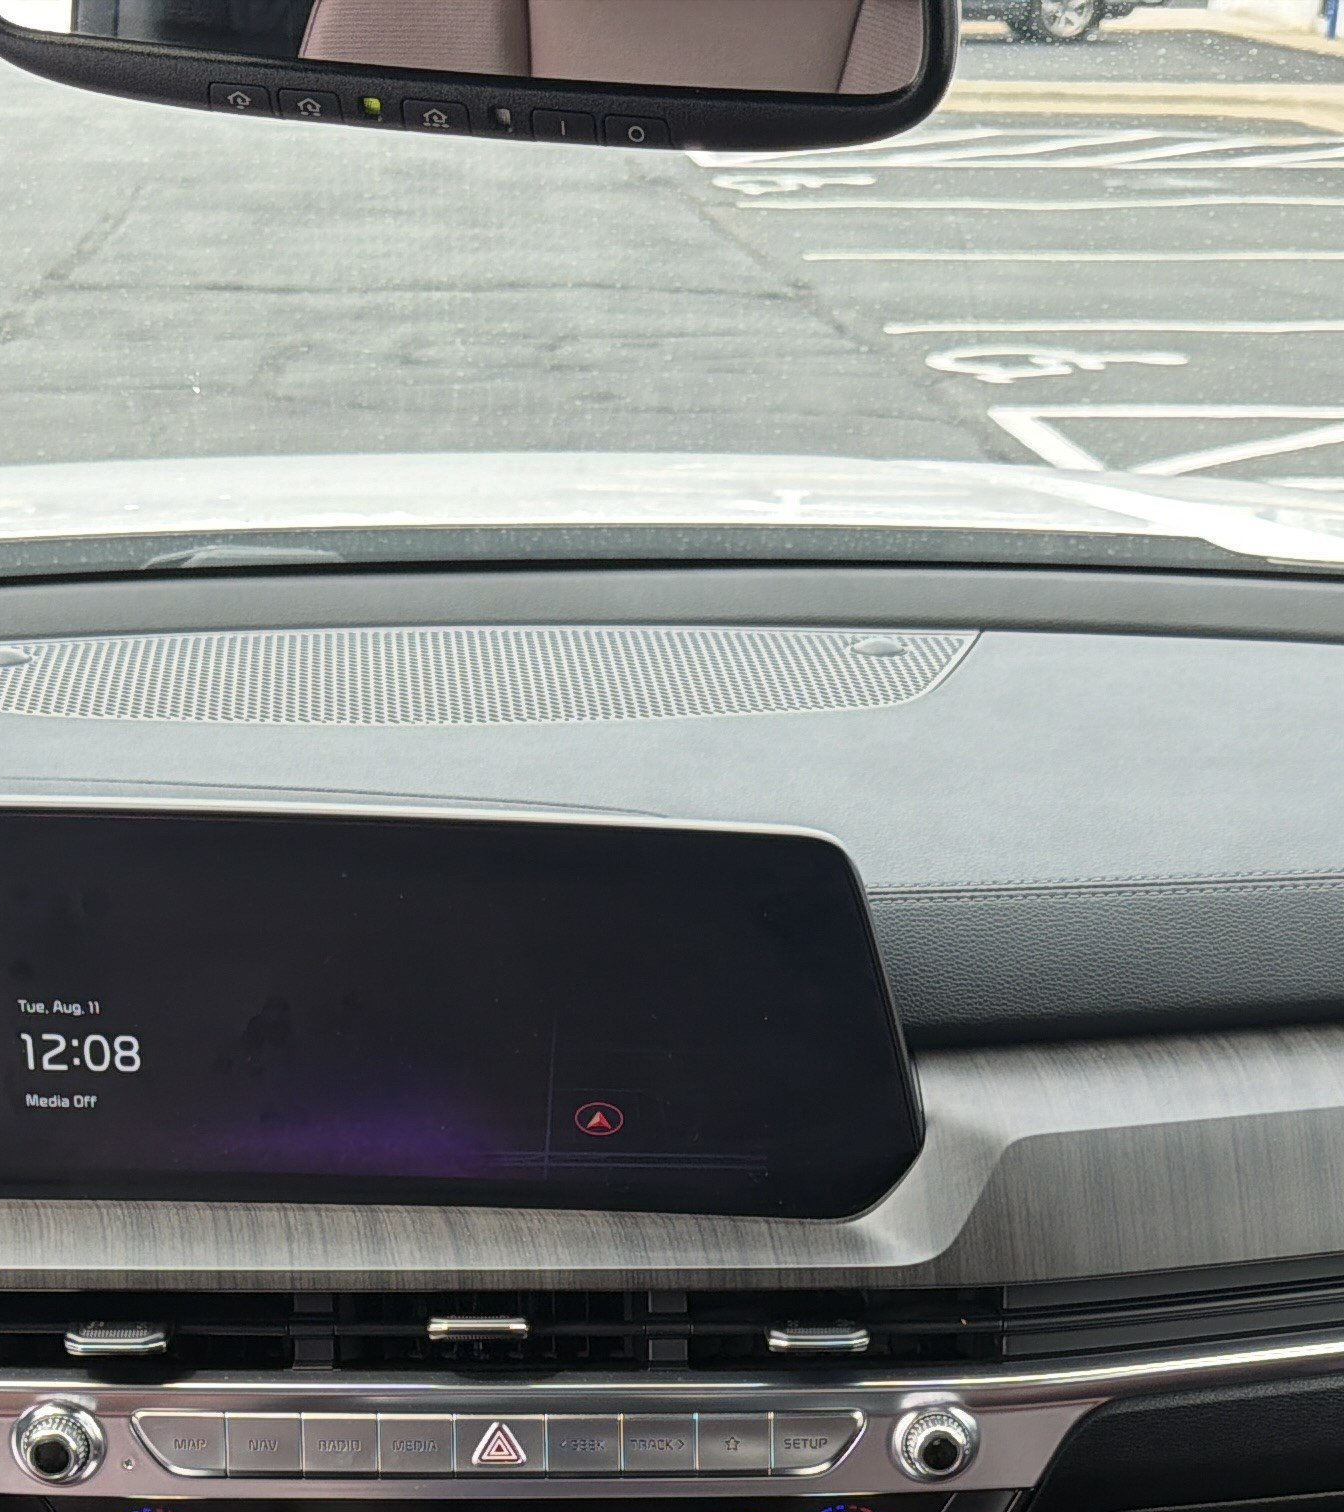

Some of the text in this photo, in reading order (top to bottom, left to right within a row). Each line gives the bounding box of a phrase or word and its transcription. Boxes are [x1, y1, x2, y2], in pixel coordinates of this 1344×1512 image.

[88, 1000, 100, 1014] 11
[20, 1033, 141, 1072] 12:08
[26, 1094, 97, 1108] Media Off
[174, 1438, 206, 1451] MAP
[248, 1439, 278, 1452] NAV
[318, 1439, 361, 1452] RADIO
[392, 1439, 438, 1452] MEDIA
[783, 1437, 828, 1450] SETUP
